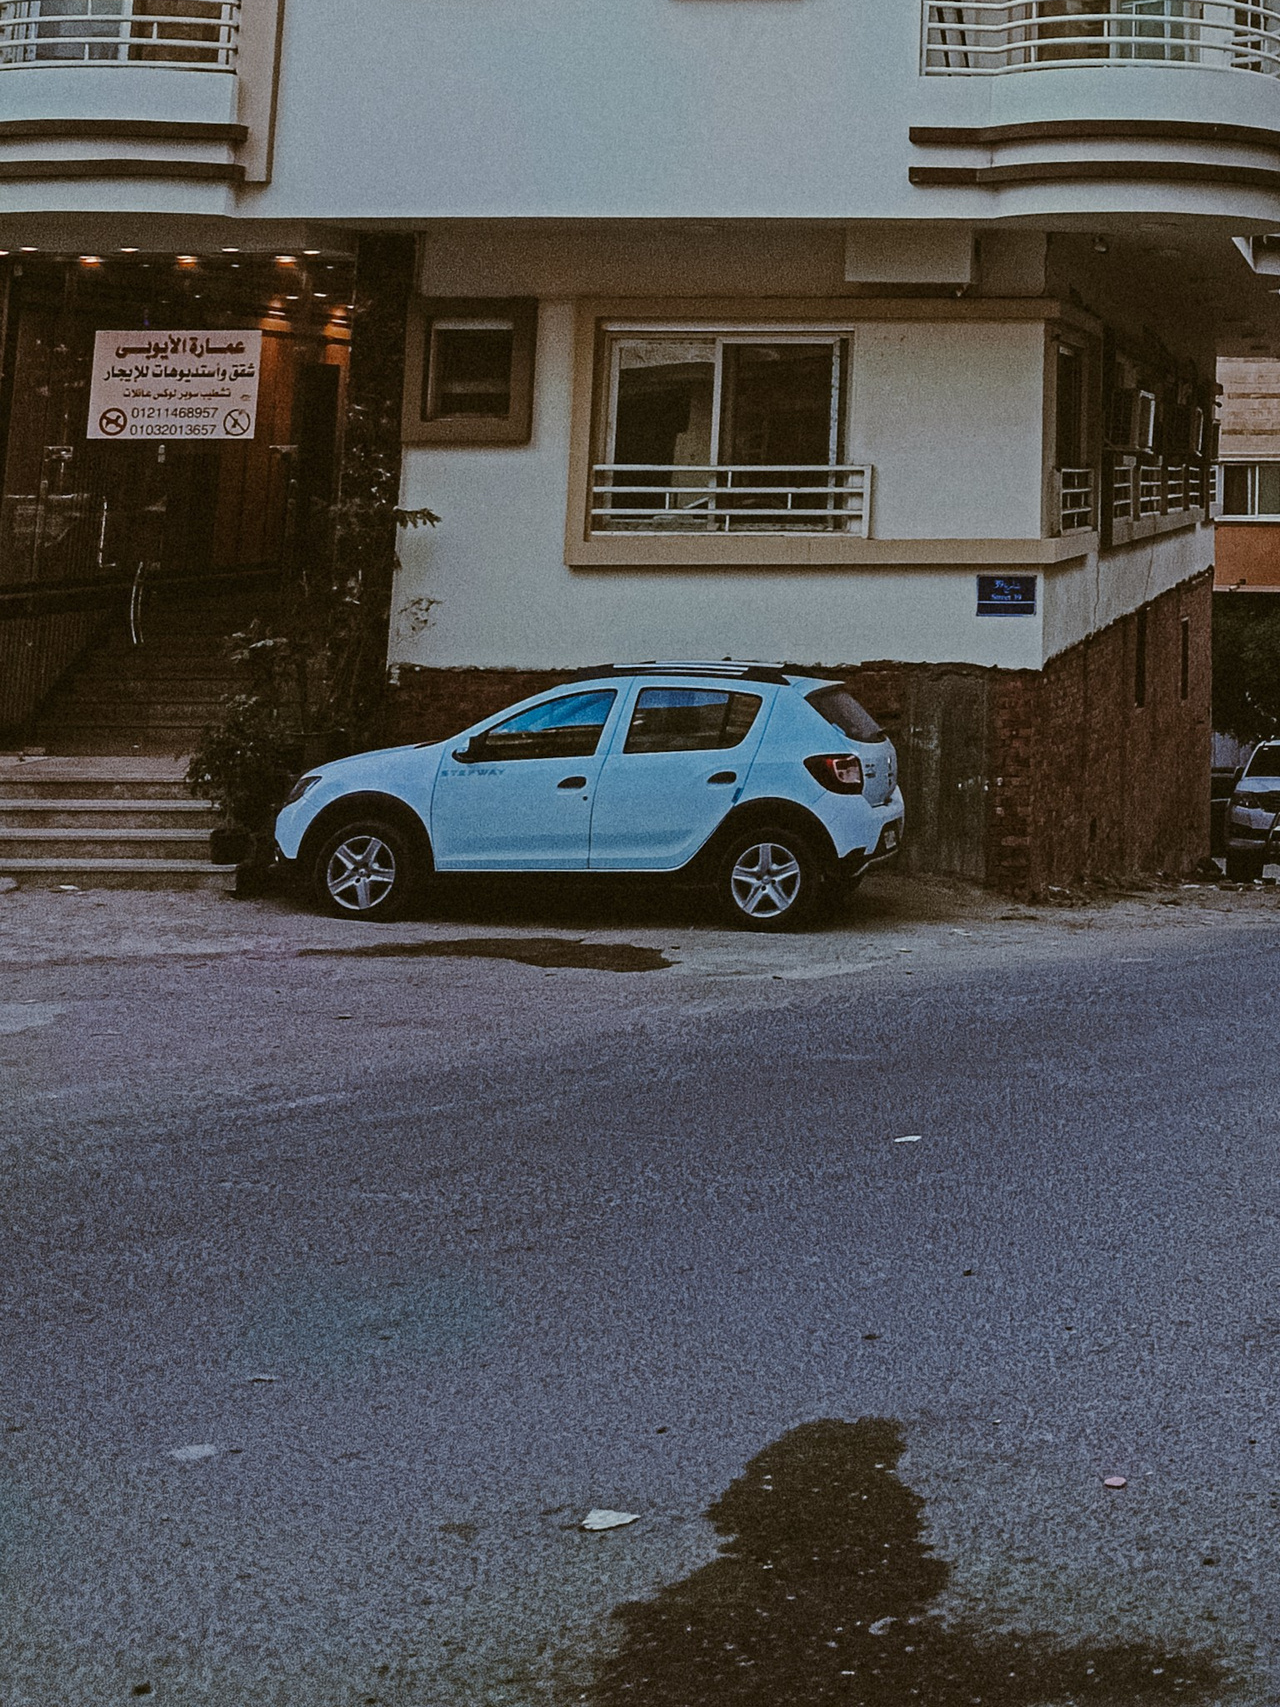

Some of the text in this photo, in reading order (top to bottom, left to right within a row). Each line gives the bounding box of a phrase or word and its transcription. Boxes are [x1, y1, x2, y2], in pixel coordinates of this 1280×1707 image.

[190, 336, 245, 358] عمارة
[103, 365, 150, 382] للإيجار
[229, 363, 255, 381] شقق
[153, 388, 177, 400] لوكس
[178, 391, 200, 400] سوبر
[200, 388, 231, 400] تشطيب
[131, 407, 218, 419] 01211468957
[130, 425, 216, 436] 01032013657
[441, 768, 506, 776] STEPWAY
